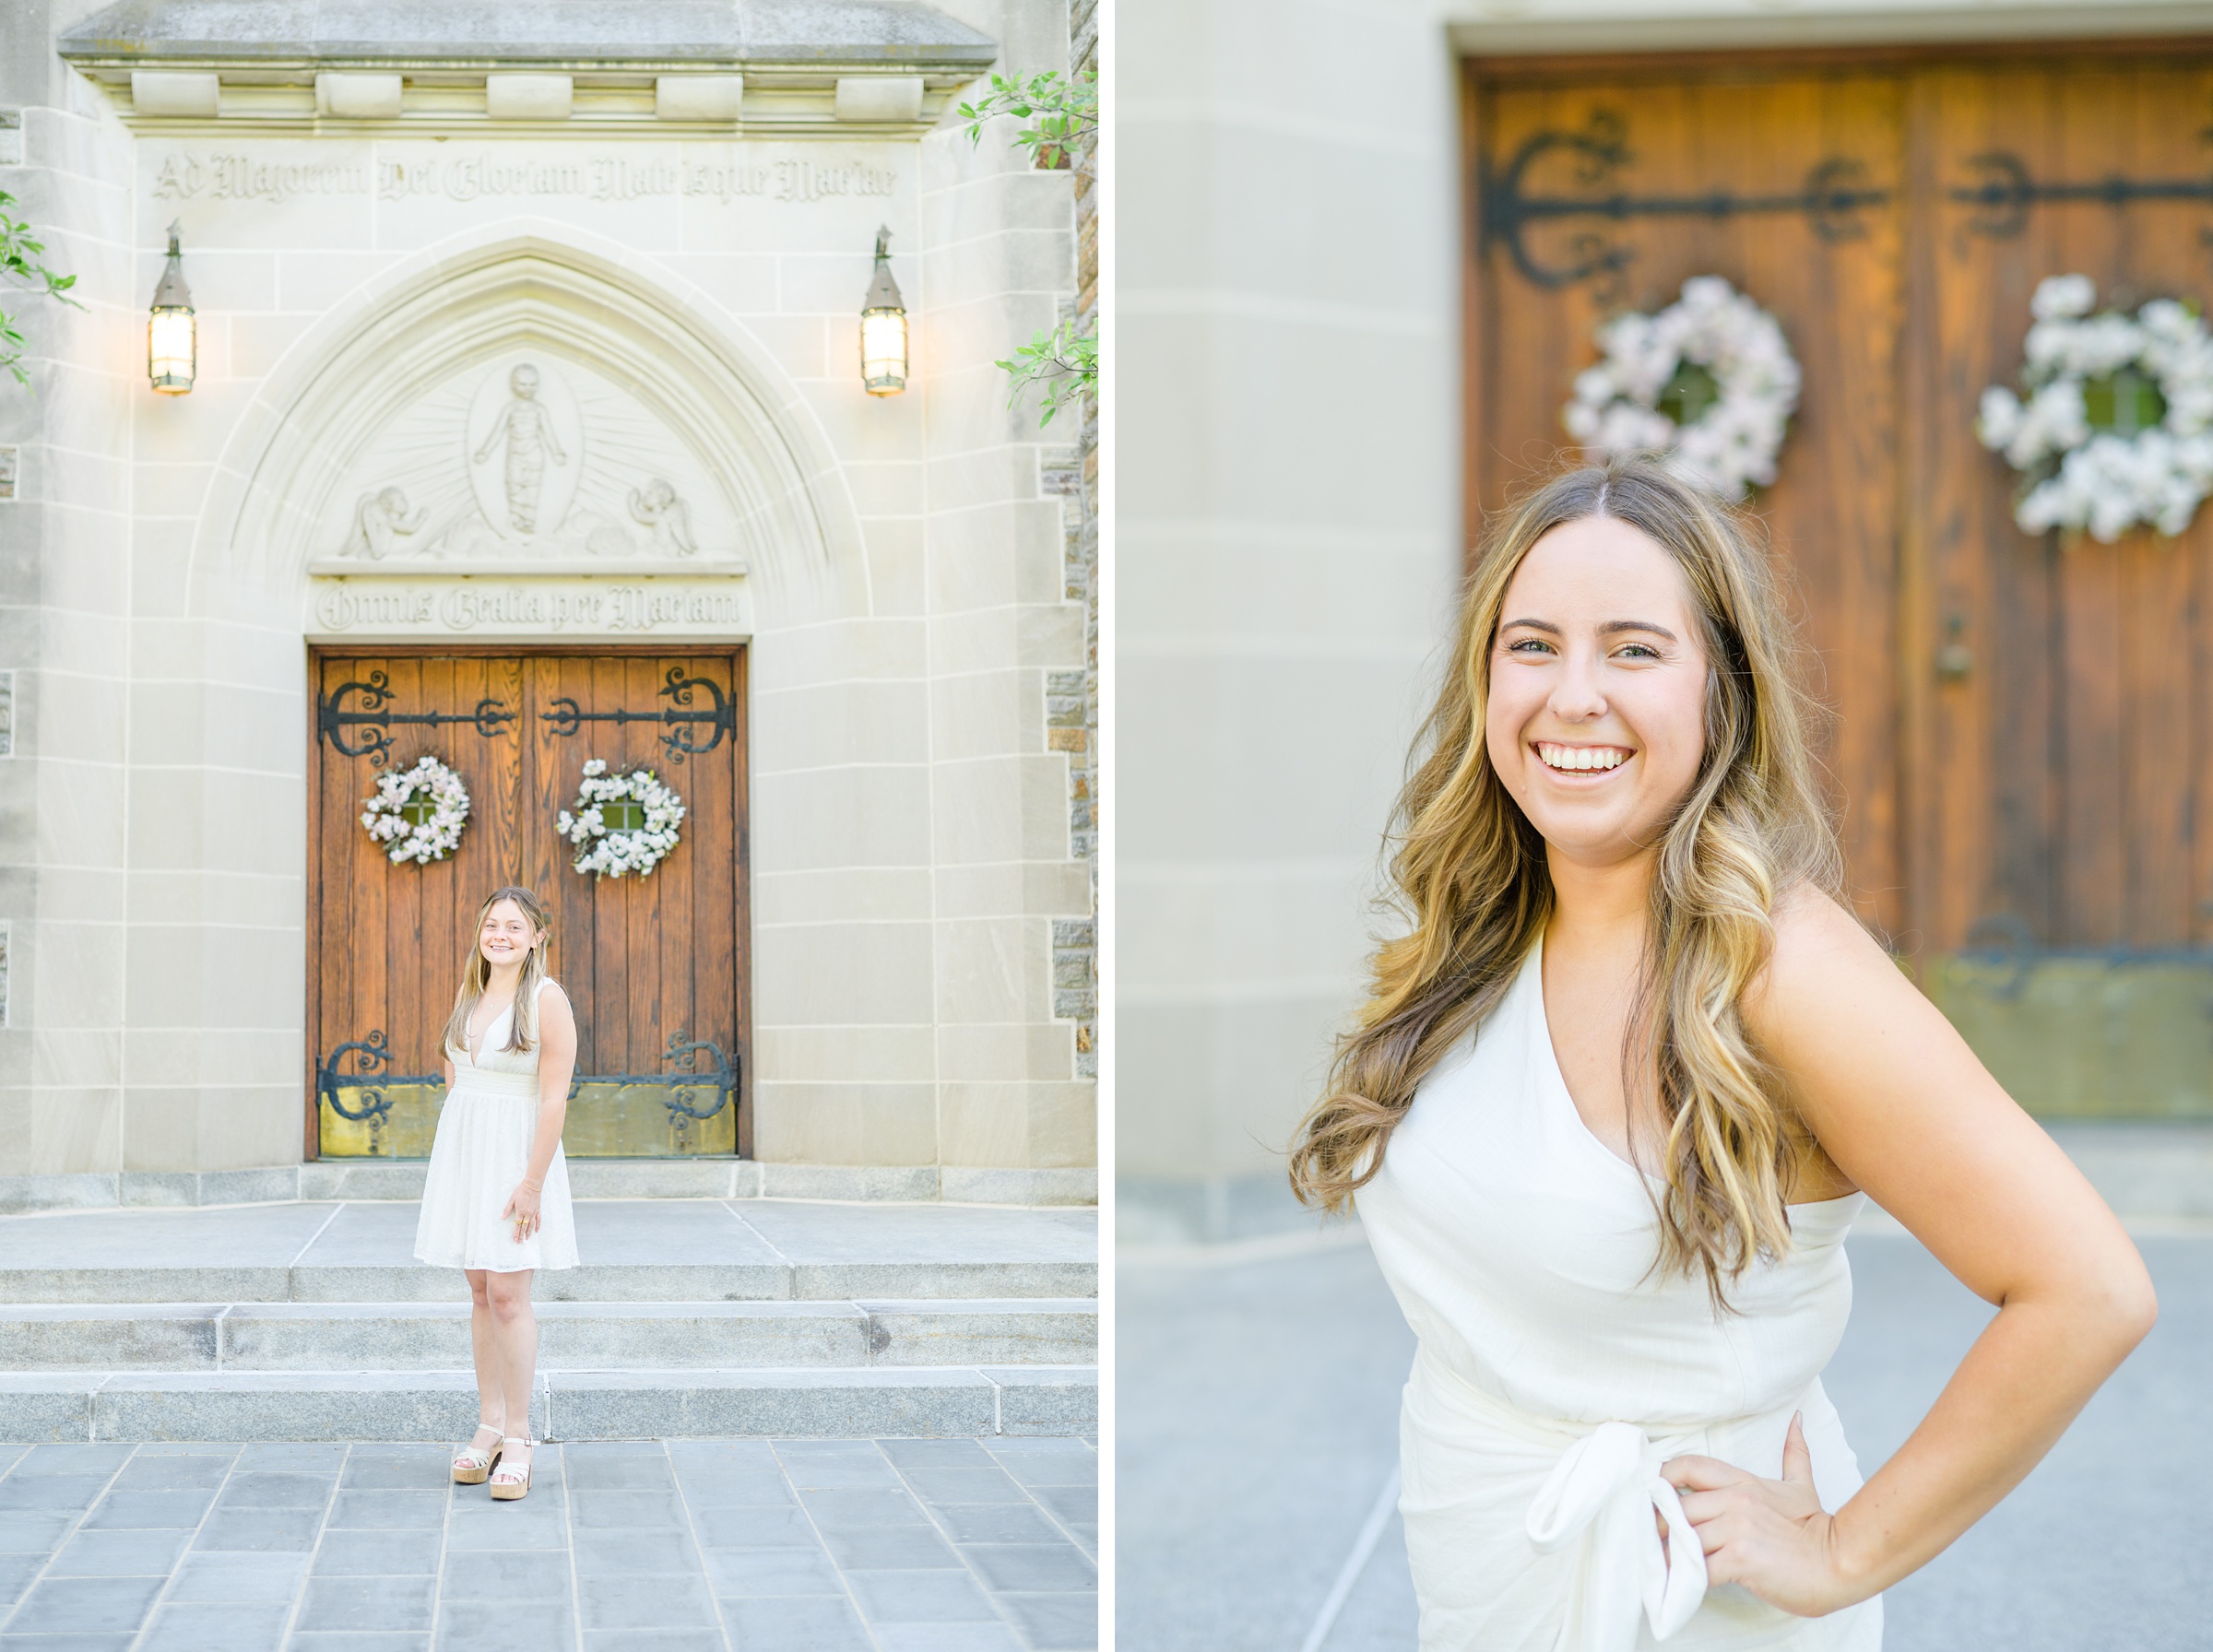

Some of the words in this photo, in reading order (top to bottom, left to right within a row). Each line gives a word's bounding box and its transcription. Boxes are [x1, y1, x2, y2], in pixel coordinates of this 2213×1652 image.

[151, 152, 205, 199] Ad
[377, 156, 437, 201] Dei
[444, 152, 586, 202] Gloriam
[315, 582, 433, 631] Omnis
[440, 583, 545, 631] Gratia
[550, 593, 603, 630] per
[608, 584, 740, 631] Mariam
